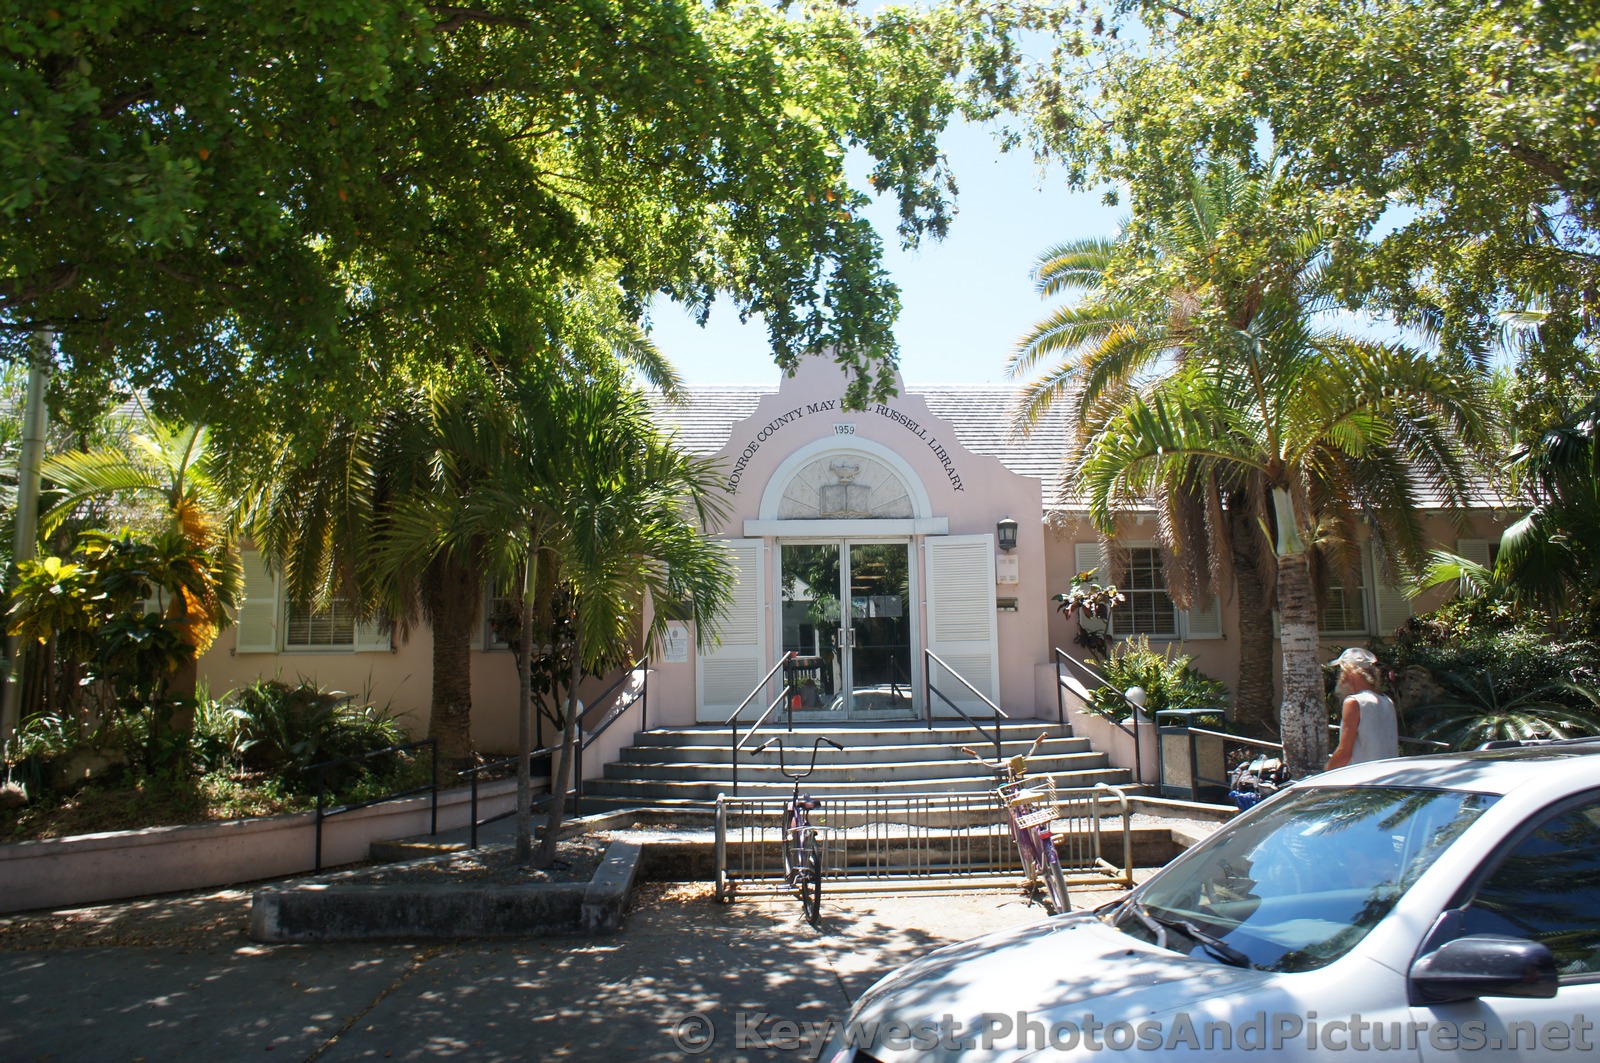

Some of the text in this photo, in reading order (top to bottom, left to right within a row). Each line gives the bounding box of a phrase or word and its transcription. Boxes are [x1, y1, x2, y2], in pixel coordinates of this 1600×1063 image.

[726, 441, 760, 495] MONROE
[757, 408, 803, 442] COUNTY
[806, 400, 836, 414] MAY
[875, 404, 927, 440] RUSSELL
[927, 438, 965, 493] LIBRARY
[835, 426, 855, 435] 1959
